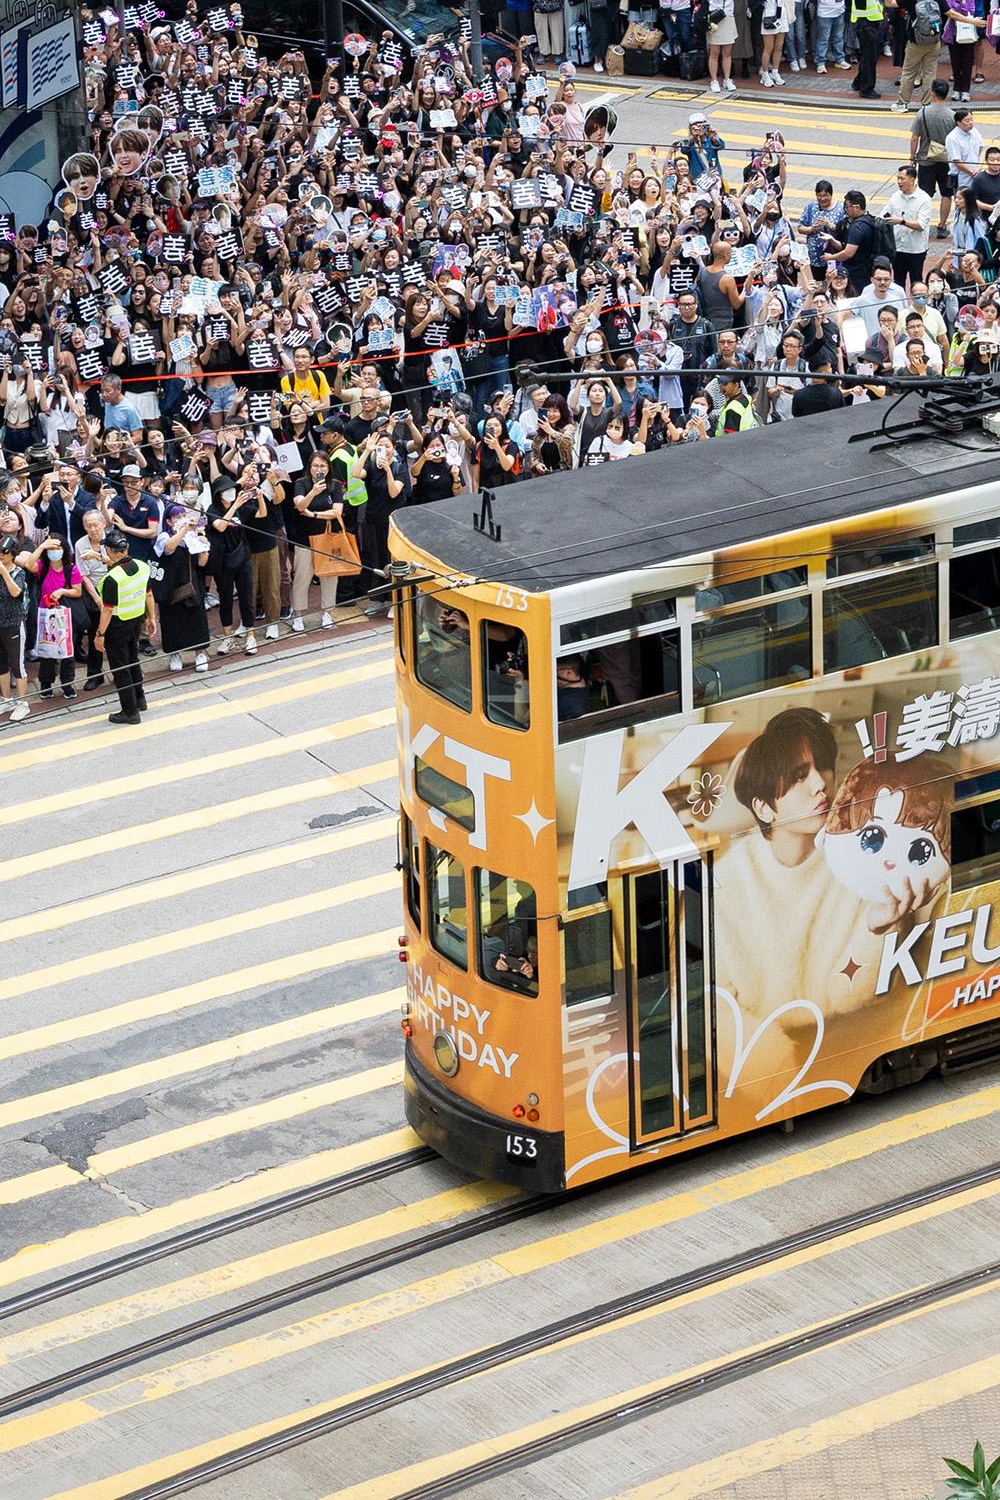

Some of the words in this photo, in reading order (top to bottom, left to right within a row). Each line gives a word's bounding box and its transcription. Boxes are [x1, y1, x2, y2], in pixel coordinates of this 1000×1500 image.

[495, 586, 529, 612] 153
[412, 962, 491, 1035] HAPPY
[506, 1135, 538, 1158] 153
